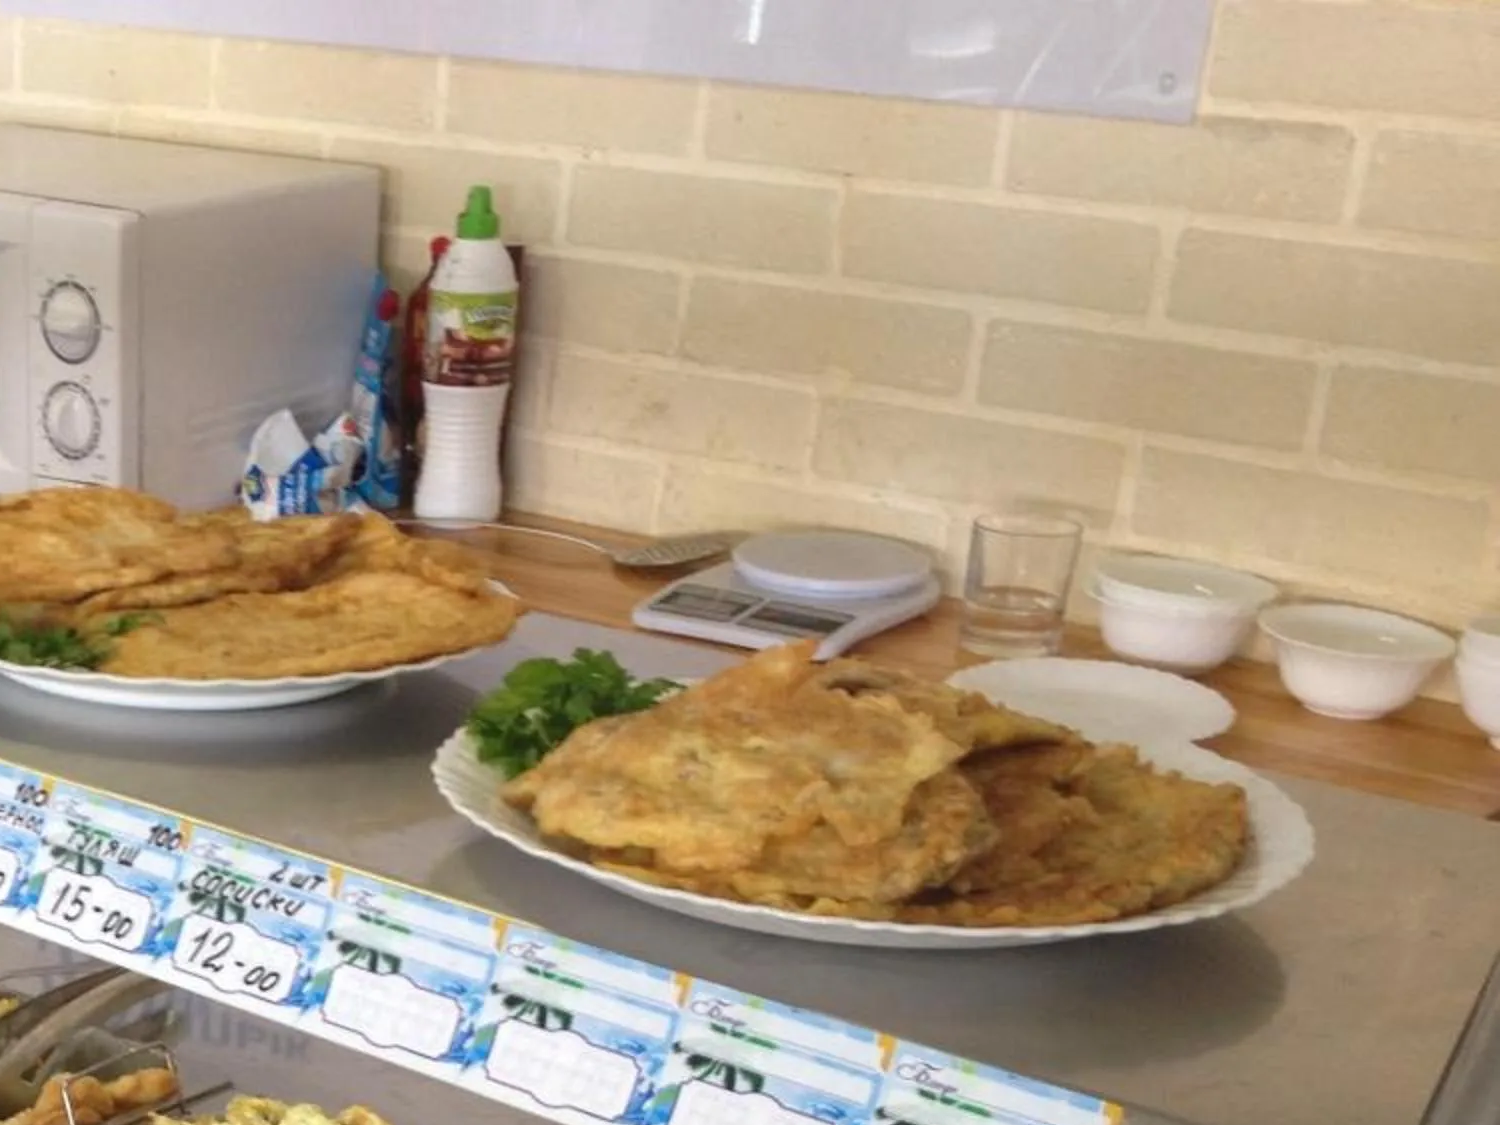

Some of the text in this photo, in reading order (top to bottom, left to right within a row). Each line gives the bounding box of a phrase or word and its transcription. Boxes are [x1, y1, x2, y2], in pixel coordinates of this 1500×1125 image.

[14, 782, 50, 807] 100
[67, 825, 142, 867] ГУЛЯШ
[147, 823, 183, 850] 100
[51, 881, 135, 940] 15-00
[190, 868, 306, 918] СОСИСКИ
[187, 927, 281, 993] 12-00
